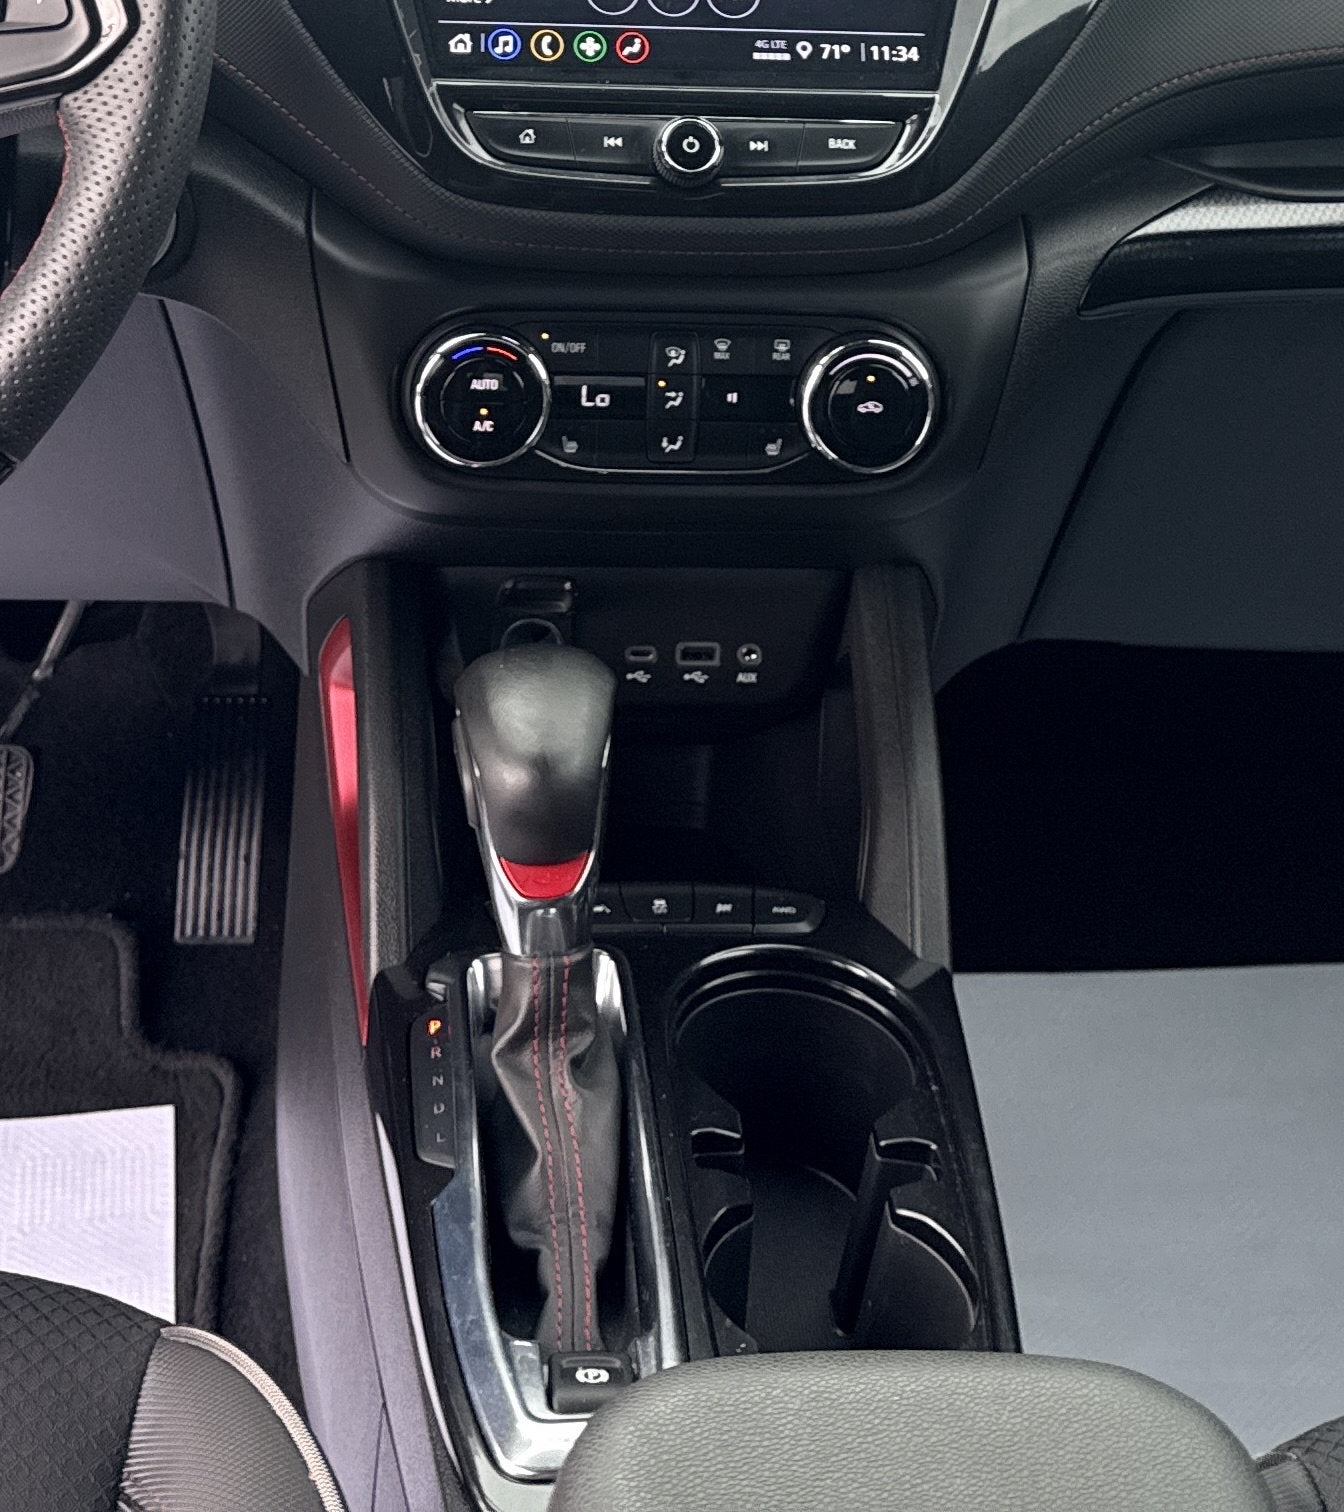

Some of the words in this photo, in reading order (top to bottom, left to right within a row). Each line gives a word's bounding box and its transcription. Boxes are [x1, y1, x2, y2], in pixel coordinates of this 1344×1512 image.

[870, 45, 920, 62] 11:34
[828, 138, 856, 150] BACK
[551, 342, 587, 354] ON/OFF
[470, 379, 499, 391] AUTO
[472, 420, 494, 432] A/C
[428, 1019, 442, 1036] P
[430, 1046, 442, 1059] R
[432, 1075, 444, 1087] N
[433, 1103, 445, 1114] D
[436, 1132, 446, 1143] L
